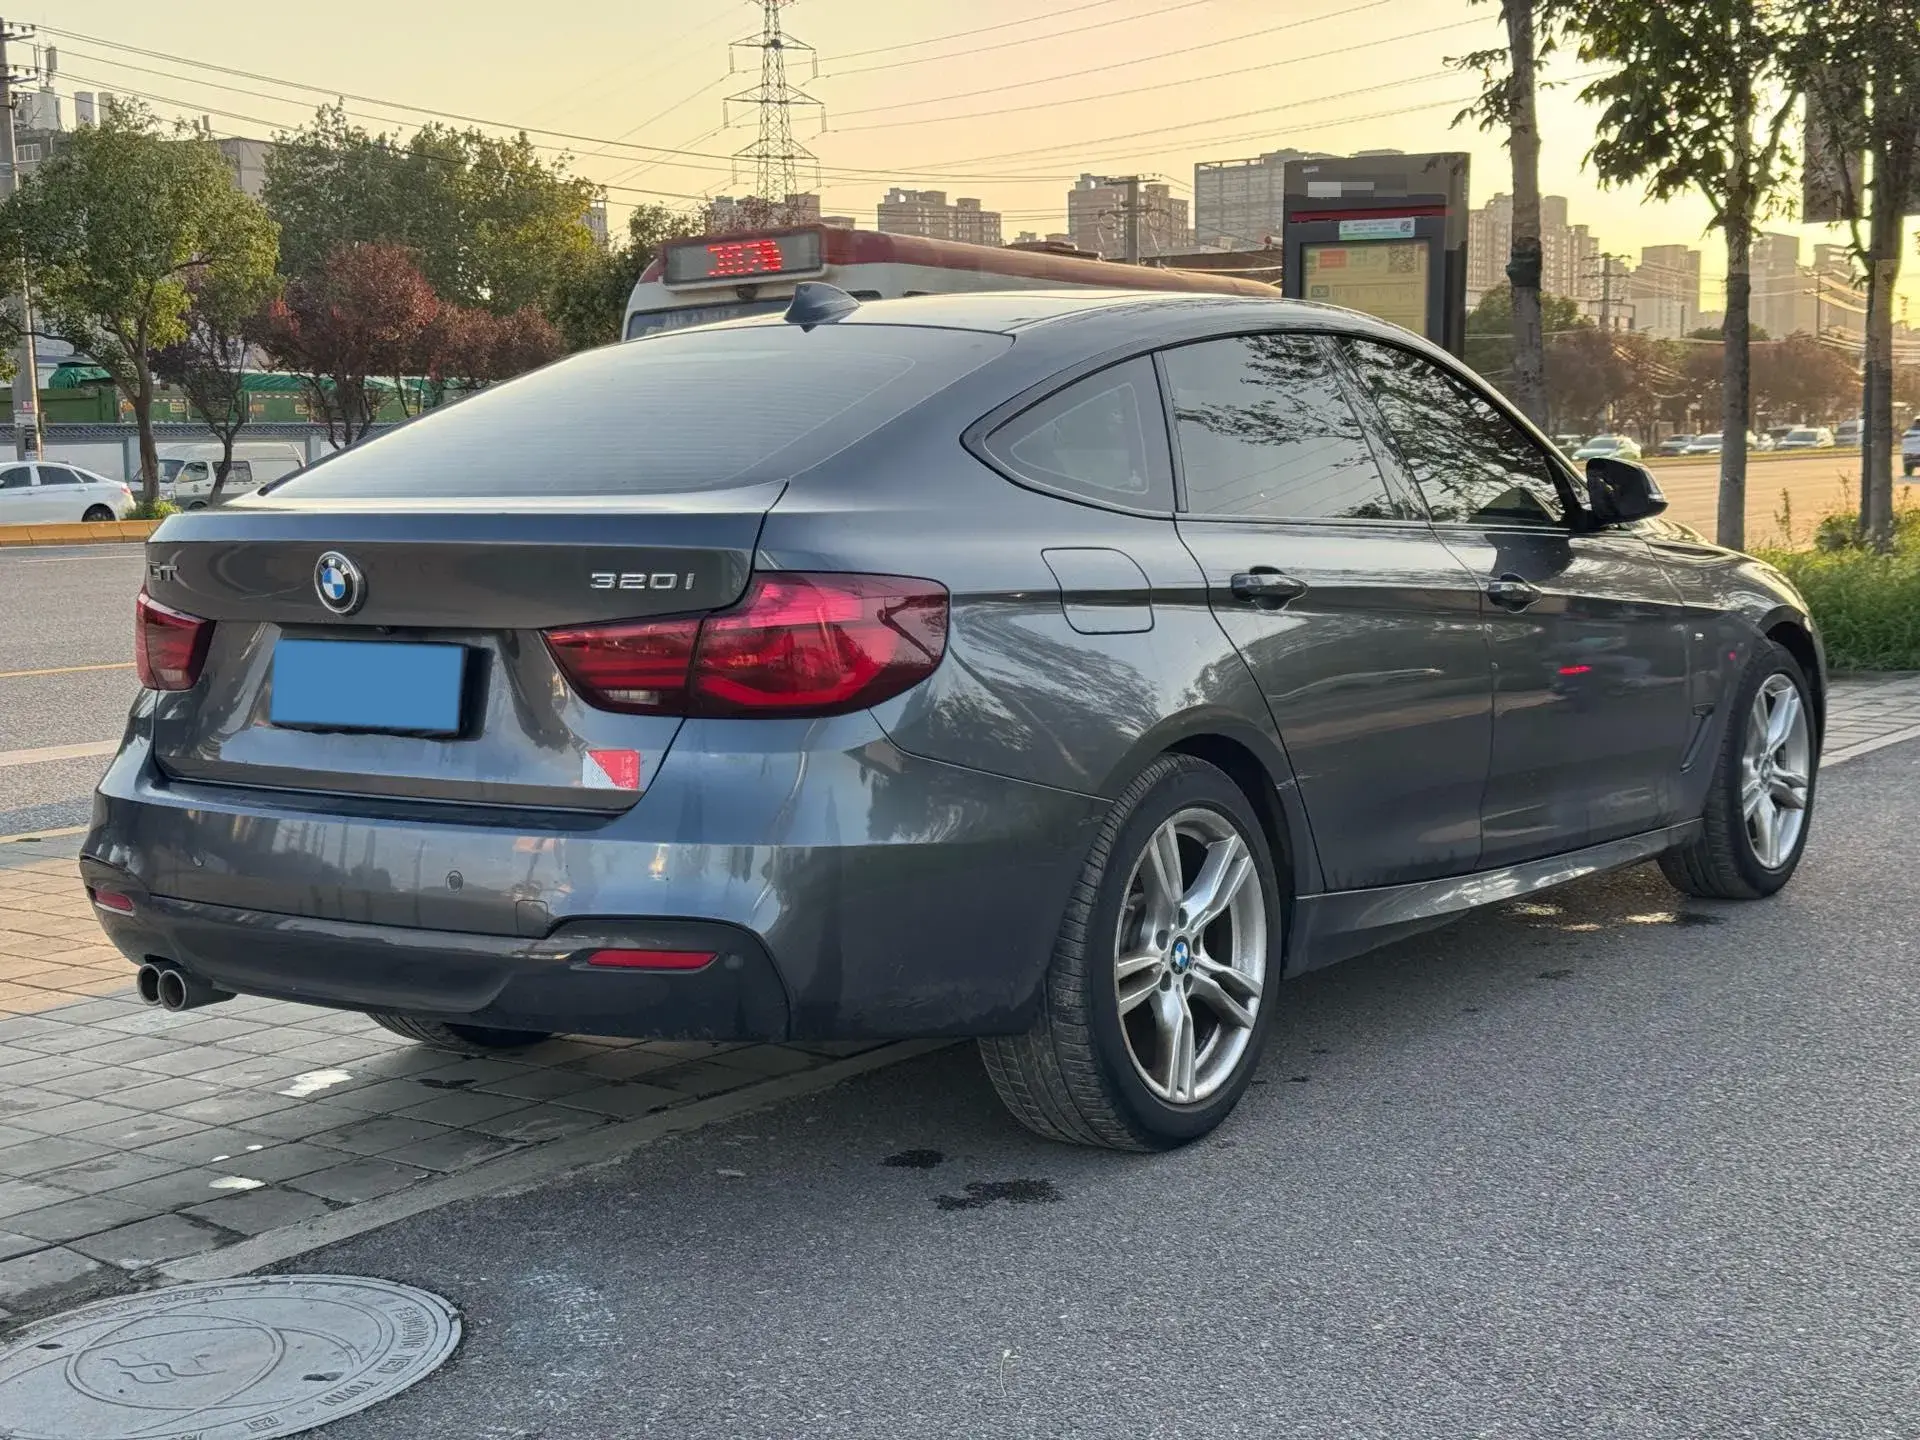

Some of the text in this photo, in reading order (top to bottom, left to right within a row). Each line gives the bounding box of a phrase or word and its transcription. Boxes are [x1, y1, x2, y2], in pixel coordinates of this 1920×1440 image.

[590, 572, 695, 590] 320i
[153, 1288, 224, 1304] AREA
[317, 1380, 385, 1407] TOWN
